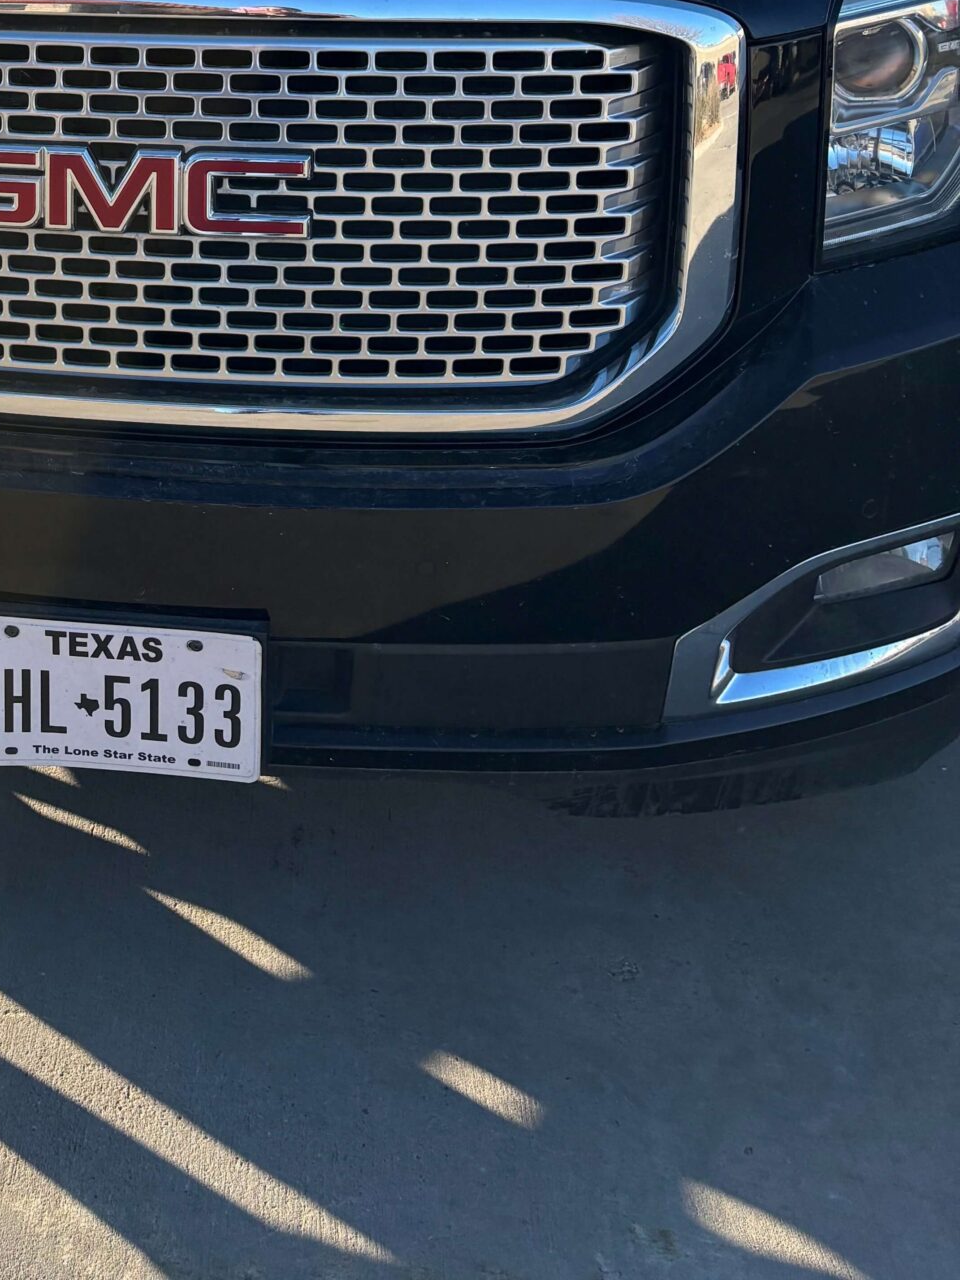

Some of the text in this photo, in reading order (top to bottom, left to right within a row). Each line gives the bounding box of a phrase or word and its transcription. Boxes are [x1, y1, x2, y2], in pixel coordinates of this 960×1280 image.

[45, 630, 163, 662] TEXAS
[104, 675, 241, 748] 5133
[33, 745, 176, 764] The Lone Star State
